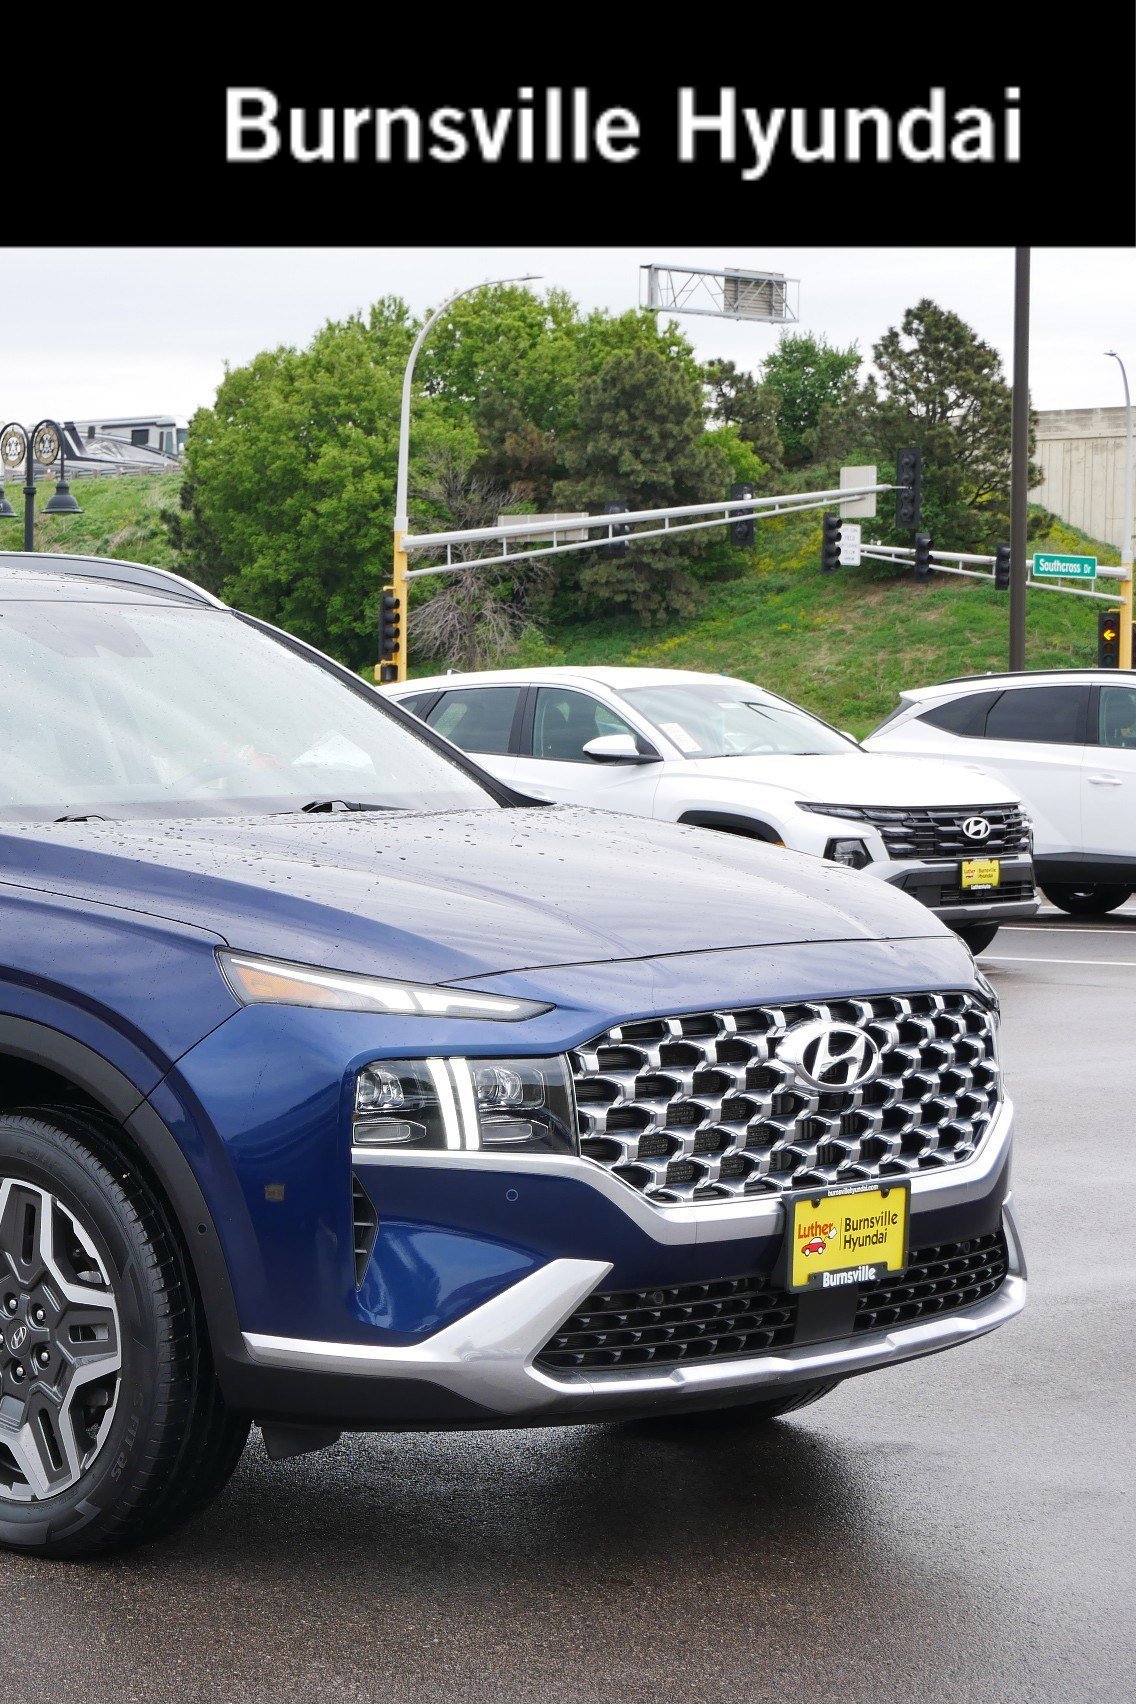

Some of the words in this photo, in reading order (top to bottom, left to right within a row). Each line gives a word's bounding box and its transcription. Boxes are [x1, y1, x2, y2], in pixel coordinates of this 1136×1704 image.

[1039, 558, 1081, 573] Southcross
[1083, 563, 1092, 574] Dr
[797, 1221, 834, 1239] Luther
[844, 1211, 898, 1233] Burnsville
[843, 1228, 888, 1252] Hyundai
[822, 1265, 876, 1288] Burnsville
